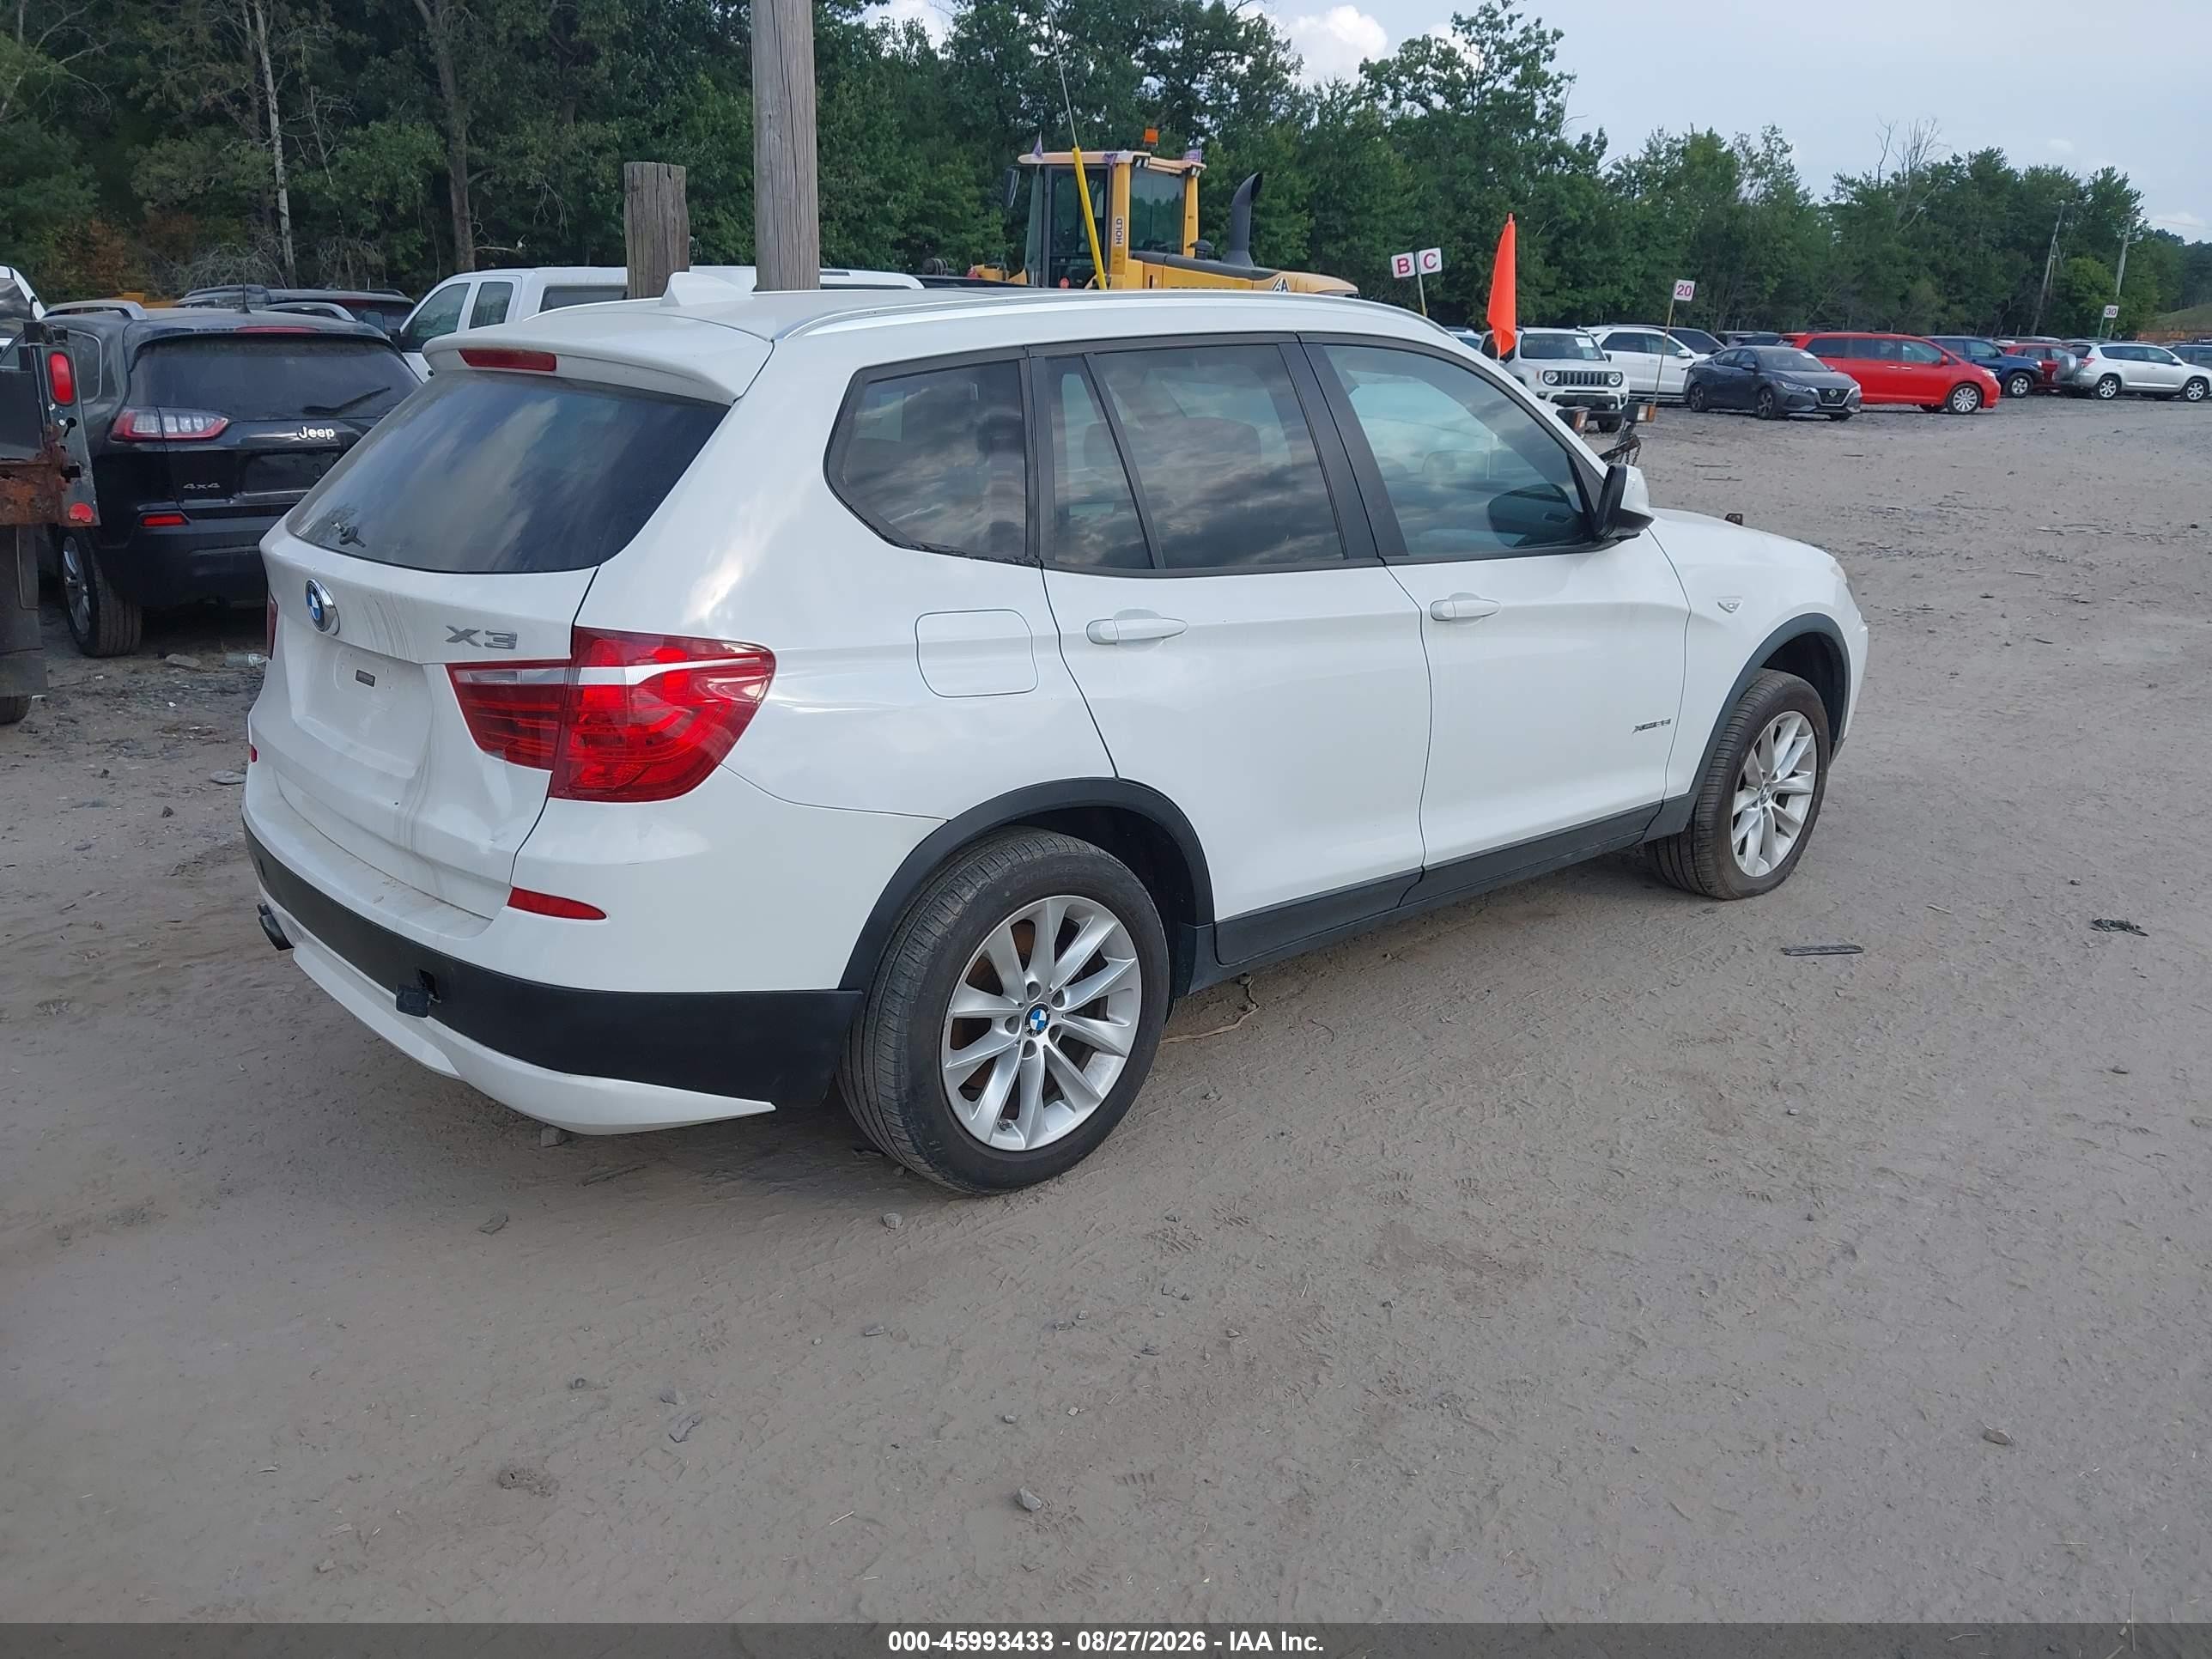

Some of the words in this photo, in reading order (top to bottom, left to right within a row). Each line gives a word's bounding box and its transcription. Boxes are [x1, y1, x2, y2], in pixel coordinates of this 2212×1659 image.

[1397, 258, 1410, 274] B
[1424, 252, 1437, 270] C
[1676, 284, 1692, 297] 20
[2106, 307, 2117, 316] 30
[298, 425, 335, 441] Jeep
[444, 625, 518, 650] X3
